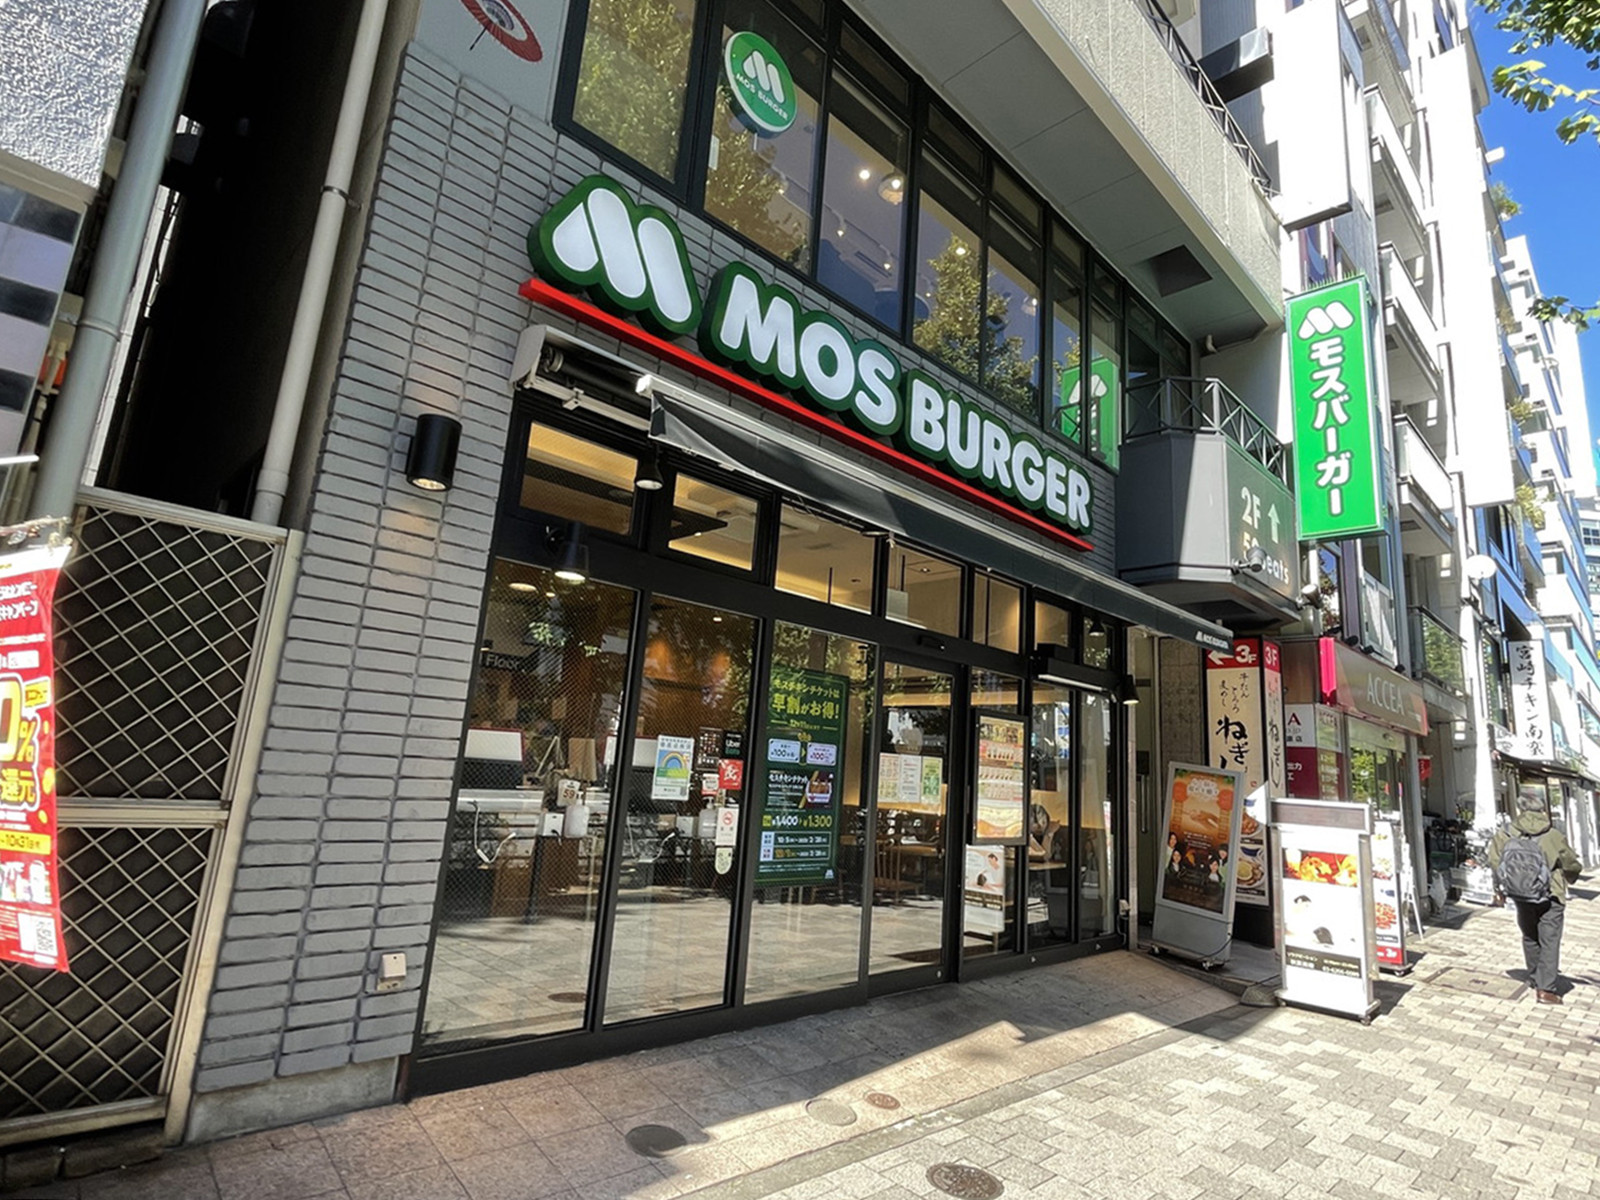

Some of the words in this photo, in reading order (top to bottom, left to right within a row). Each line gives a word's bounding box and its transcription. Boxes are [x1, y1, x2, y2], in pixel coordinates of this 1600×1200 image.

[736, 73, 756, 93] MOS
[757, 90, 788, 120] BURGER
[720, 273, 897, 427] MOS
[910, 377, 1092, 530] BURGER
[1309, 336, 1352, 516] モスバーガー
[1241, 486, 1261, 530] 2F
[1262, 555, 1290, 585] eats
[1235, 644, 1257, 665] 3F
[1264, 645, 1278, 668] 3F
[1367, 671, 1406, 716] ACCEA
[725, 740, 741, 749] Uber
